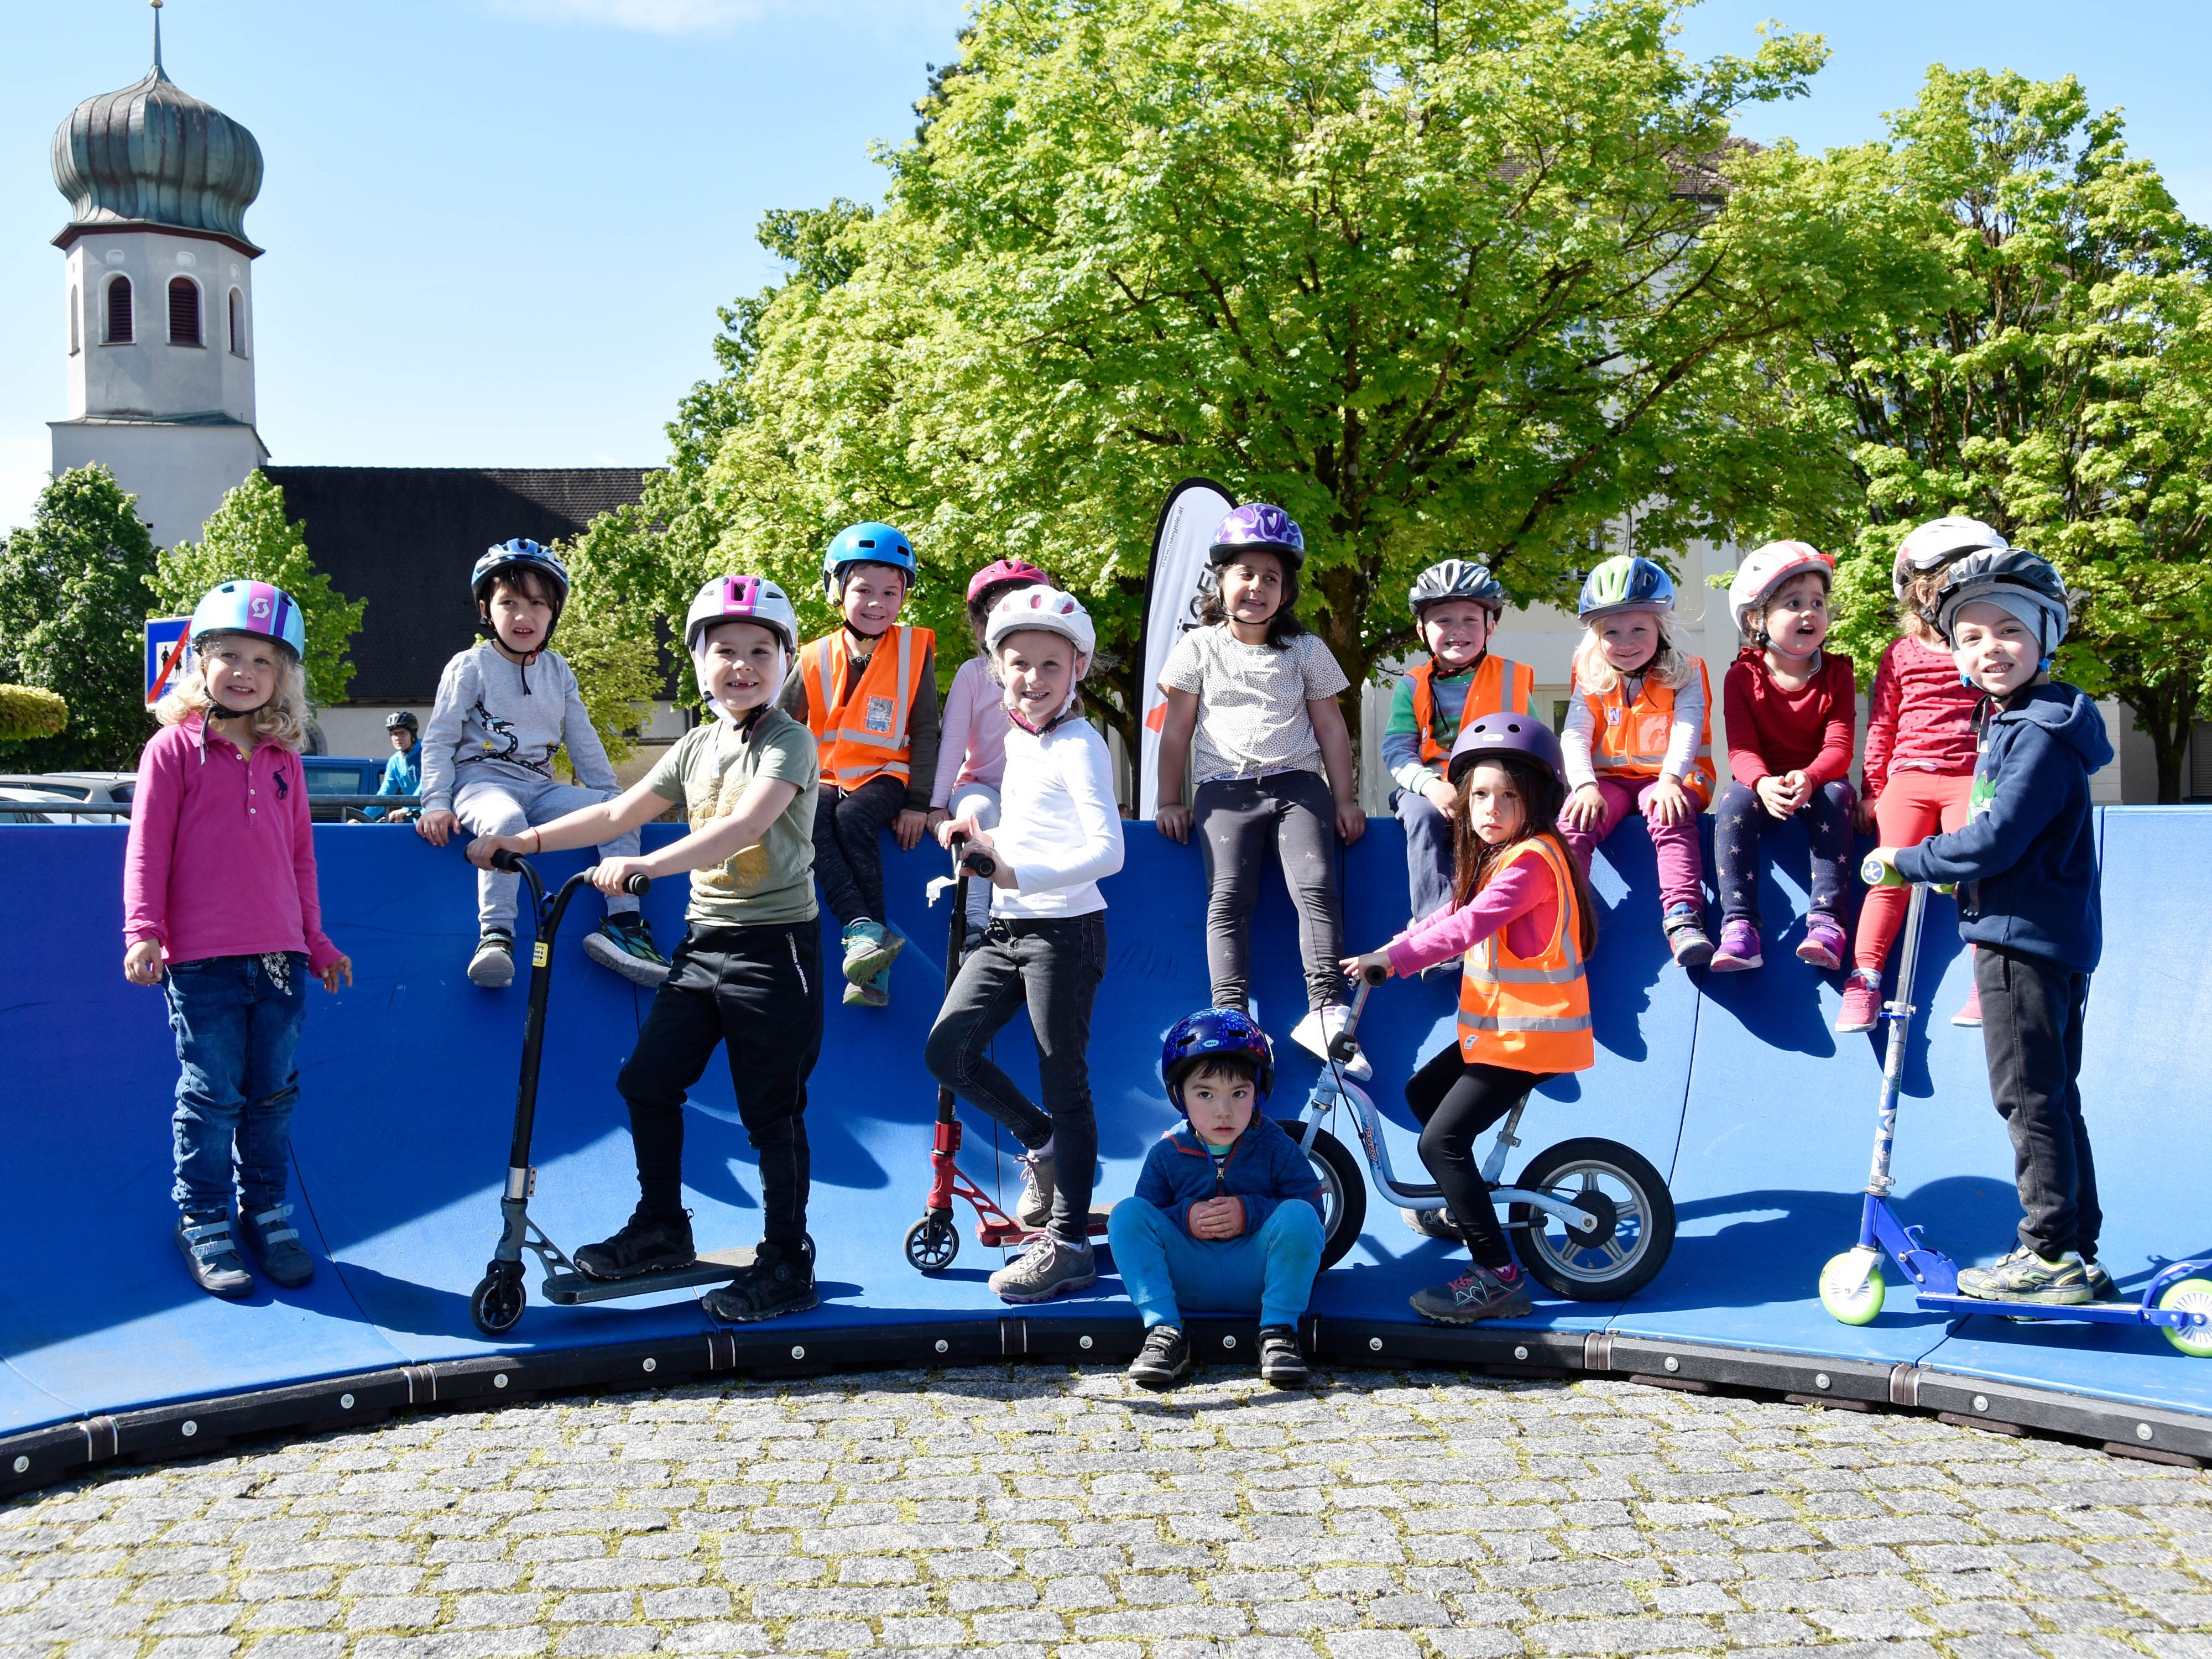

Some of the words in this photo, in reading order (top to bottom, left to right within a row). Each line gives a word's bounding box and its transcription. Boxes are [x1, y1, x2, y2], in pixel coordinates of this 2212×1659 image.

[1161, 506, 1184, 568] www.naegele.at
[796, 964, 808, 994] ARMOUR
[1364, 1128, 1378, 1162] PUKY
